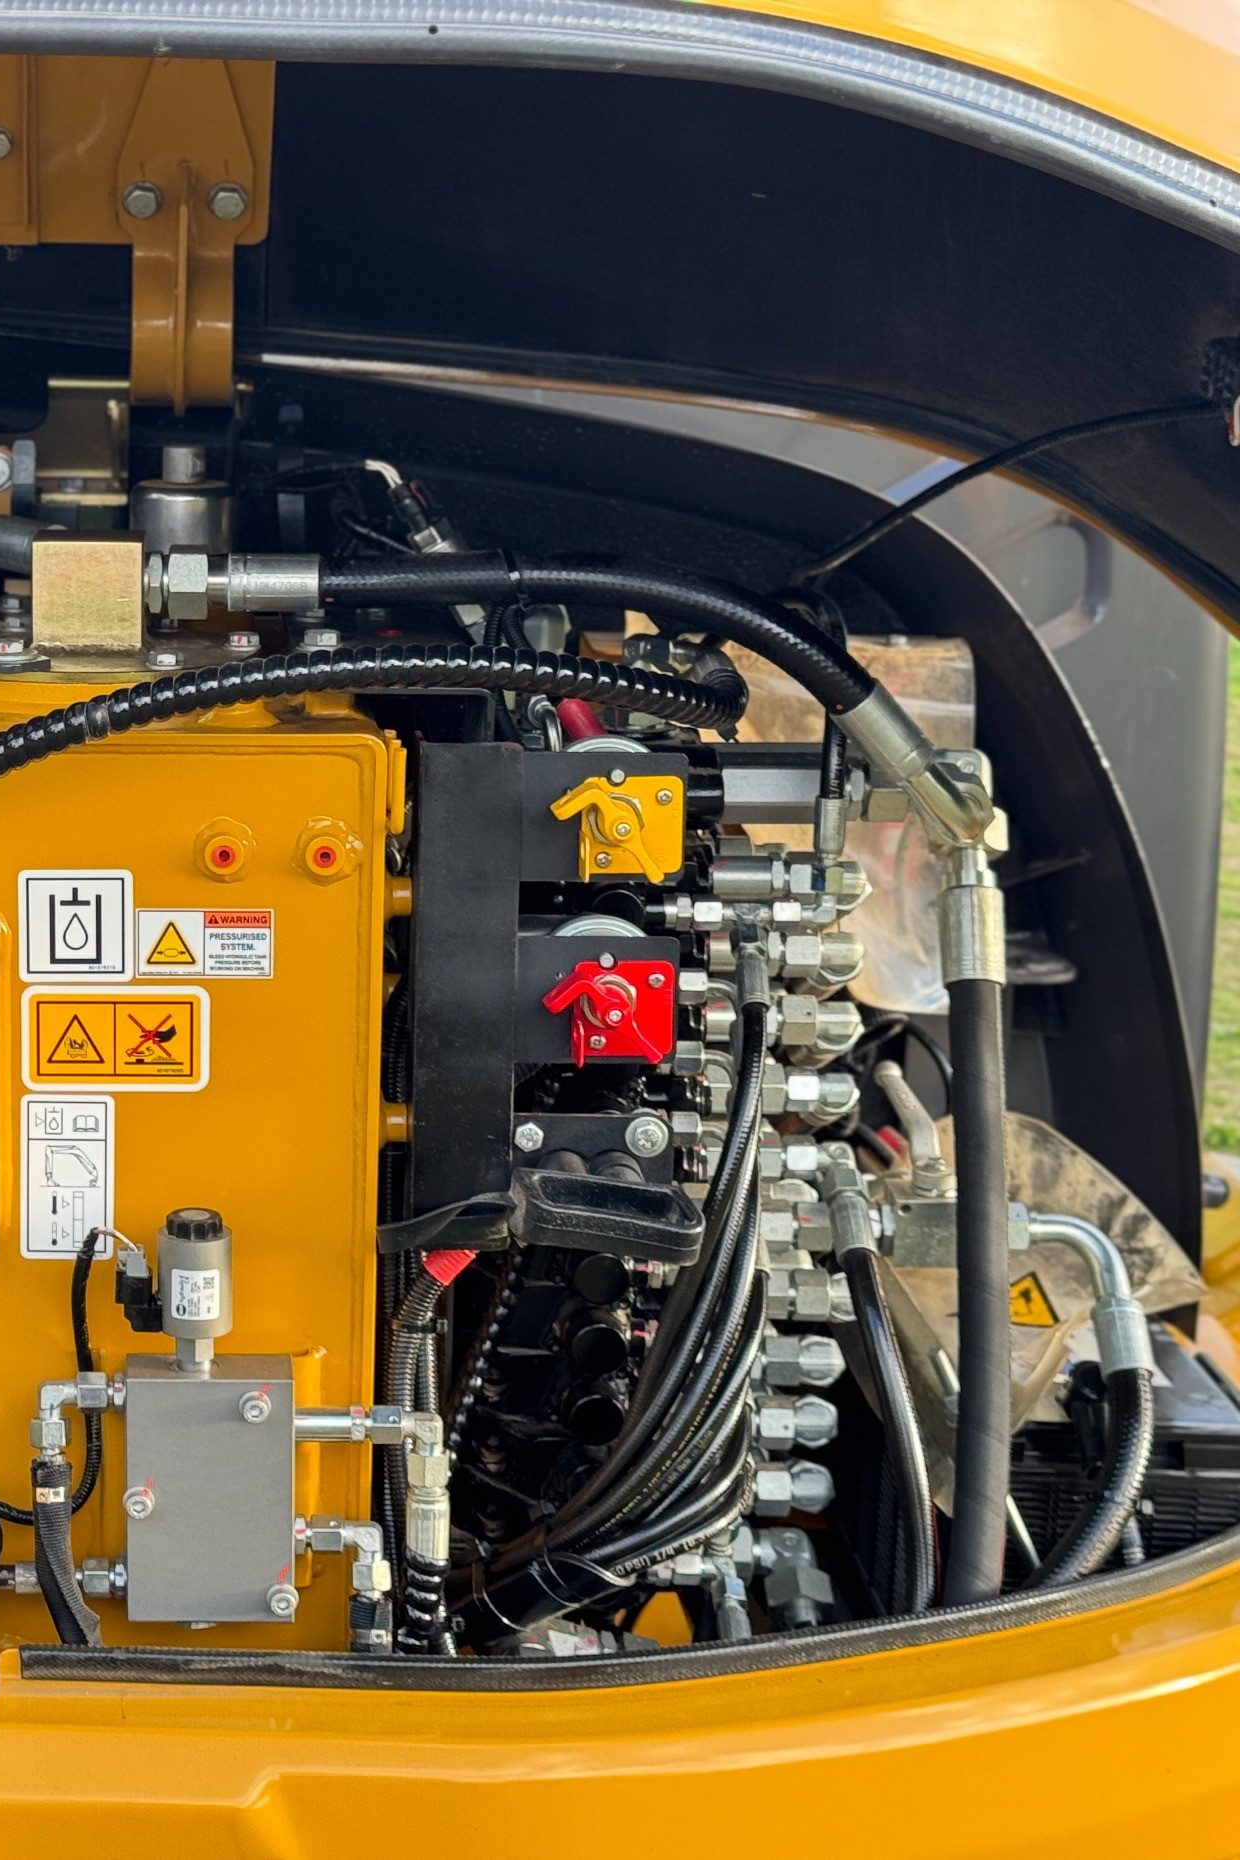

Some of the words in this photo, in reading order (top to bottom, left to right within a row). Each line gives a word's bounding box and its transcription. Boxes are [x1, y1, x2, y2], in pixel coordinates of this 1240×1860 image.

[220, 916, 268, 924] WARNING
[209, 933, 267, 941] PRESSURISED
[220, 943, 256, 951] SYSTEM.
